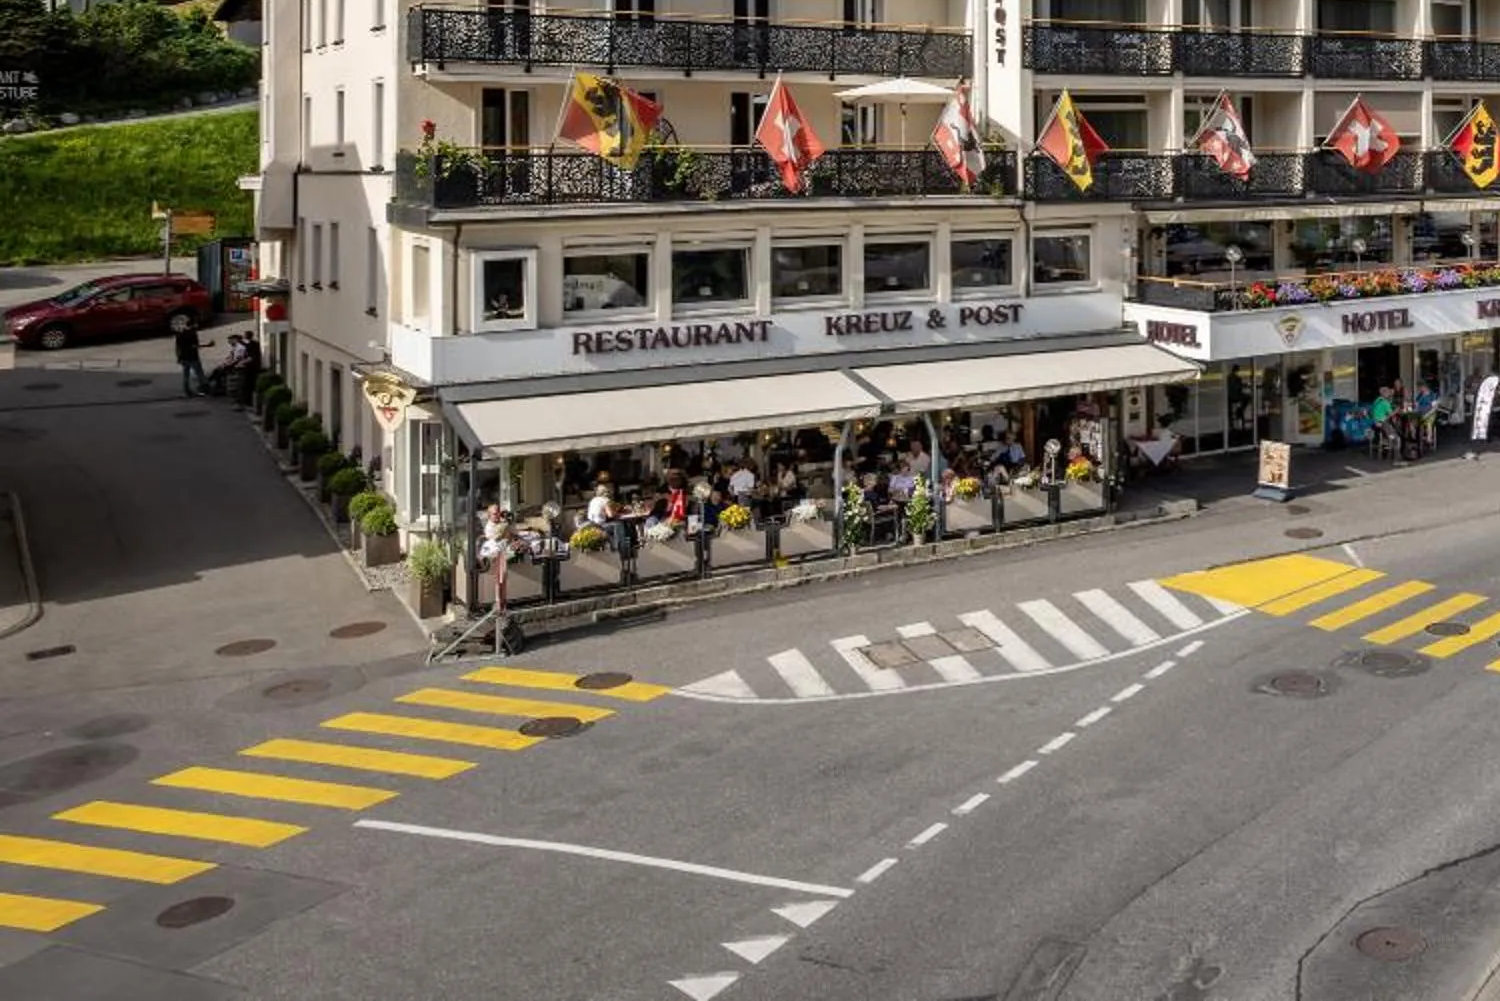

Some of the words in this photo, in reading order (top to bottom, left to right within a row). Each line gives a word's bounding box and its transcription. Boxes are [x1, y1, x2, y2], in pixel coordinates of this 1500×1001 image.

[572, 320, 774, 355] RESTAURANT
[825, 310, 913, 336] KREUZ
[926, 308, 946, 330] &
[959, 304, 1024, 327] POST
[1146, 320, 1202, 349] HOTEL
[1342, 308, 1415, 334] HOTEL
